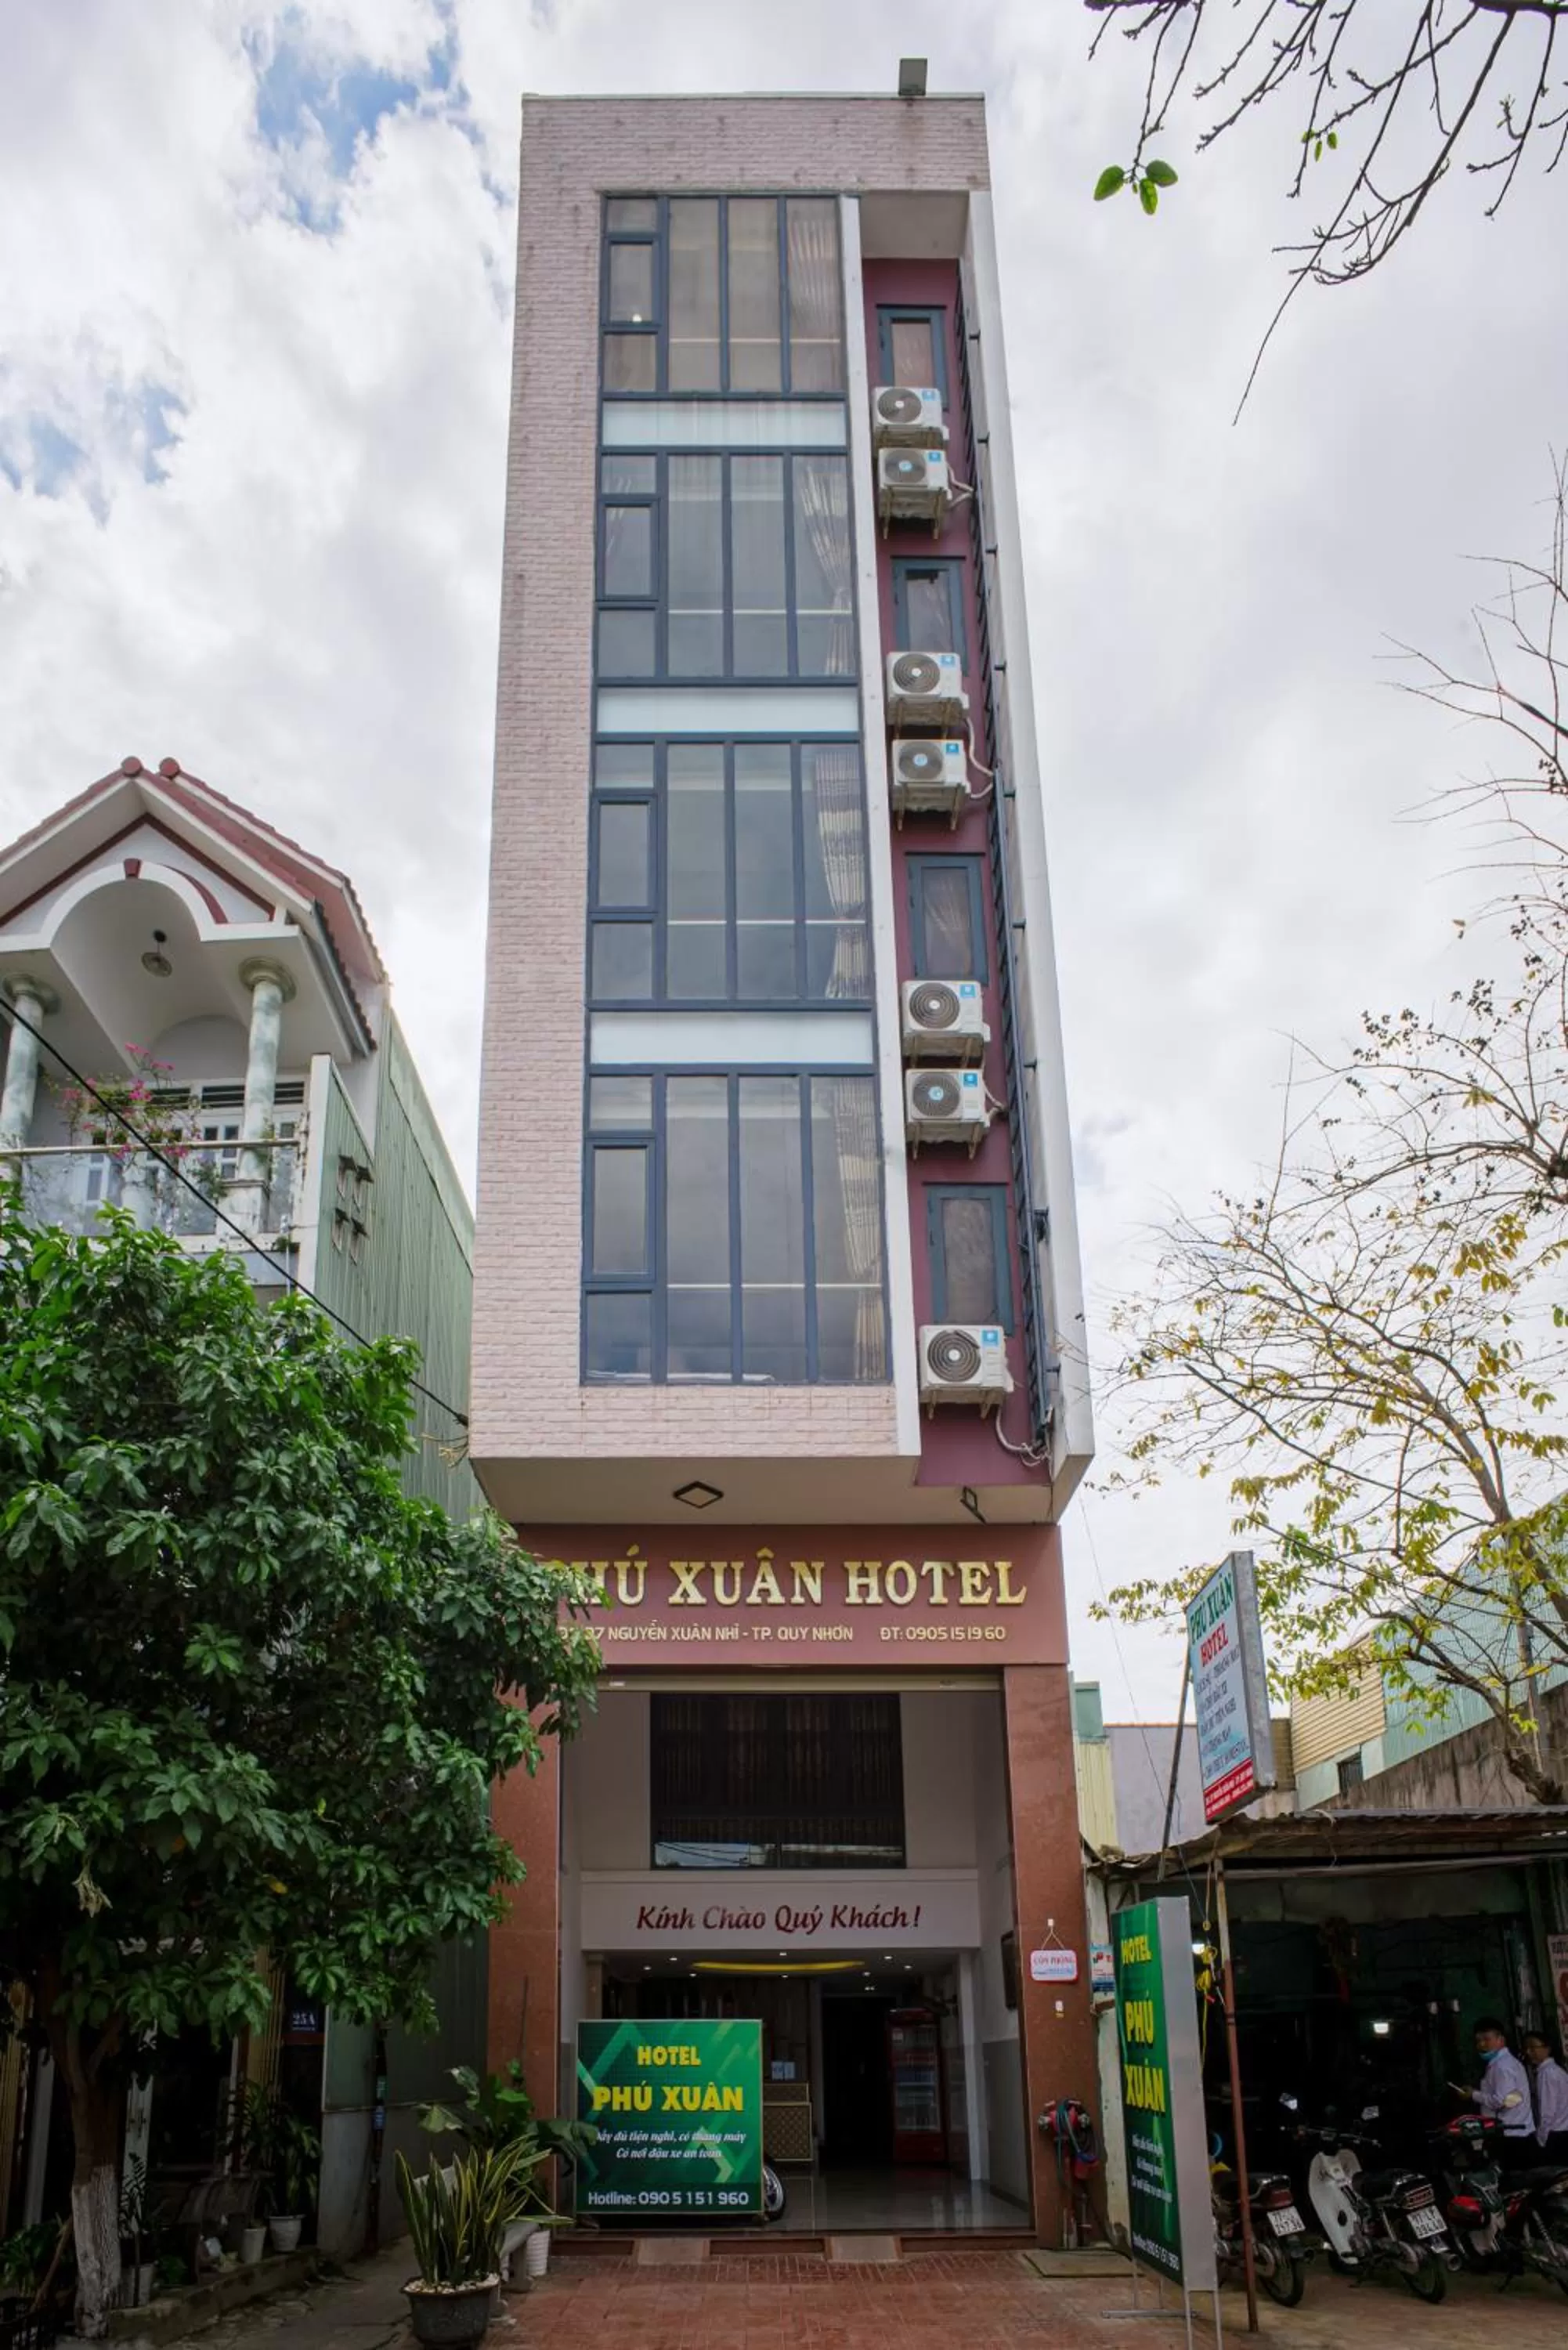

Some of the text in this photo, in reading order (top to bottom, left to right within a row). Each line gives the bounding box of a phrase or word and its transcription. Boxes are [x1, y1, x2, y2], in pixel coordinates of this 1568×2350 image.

[538, 1544, 1028, 1606] HÚ XUÂN HOTEL
[608, 1619, 667, 1640] NGUYỄN
[670, 1622, 712, 1640] XUÂN
[752, 1626, 774, 1640] TP.
[777, 1626, 810, 1640] QUY
[812, 1625, 853, 1640] NHƠN
[880, 1626, 902, 1640] ĐT:
[905, 1626, 948, 1640] 0905
[1200, 1622, 1229, 1668] HOTEL
[636, 1904, 694, 1930] Kính
[703, 1905, 767, 1930] Chào
[774, 1904, 823, 1936] Quý
[1121, 1933, 1152, 1965] HOTEL
[1125, 1990, 1154, 2044] PHÚ
[637, 2045, 701, 2066] HOTEL
[592, 2081, 743, 2111] PHÚ XUÂN
[1124, 2058, 1165, 2113] XUÂN
[616, 2147, 629, 2158] Có
[588, 2191, 750, 2205] Hotline: 0905 151 960
